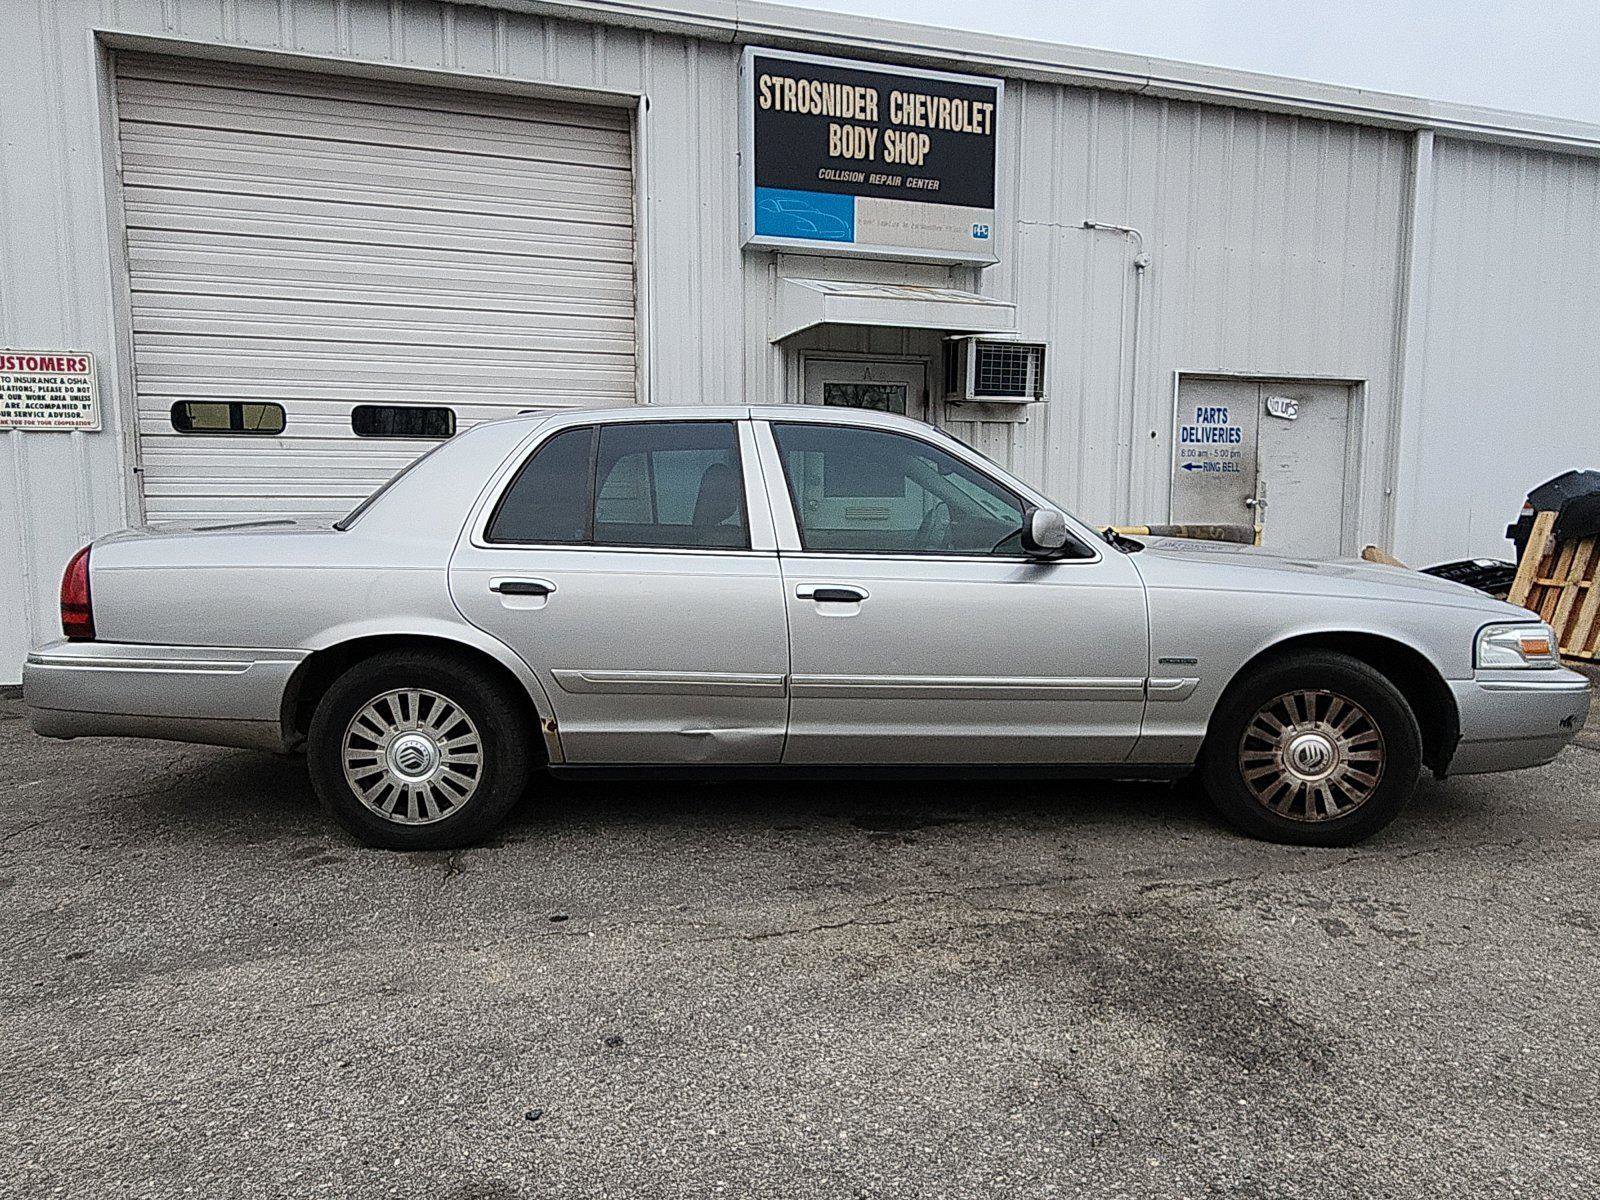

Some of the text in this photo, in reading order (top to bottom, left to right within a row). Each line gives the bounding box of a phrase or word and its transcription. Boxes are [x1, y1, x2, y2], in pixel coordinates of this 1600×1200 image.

[759, 74, 994, 135] STROSNIDER CHEVROLET
[829, 123, 930, 166] BODY SHOP
[818, 168, 940, 191] COLLISION REPAIR CENTER
[13, 376, 58, 385] INSURANCE
[67, 377, 88, 385] OSHA
[0, 385, 35, 393] LATIONS,
[77, 386, 90, 394] NOT
[25, 402, 78, 410] ACCOMPANIED
[48, 411, 84, 419] ADVISOR.
[1196, 407, 1228, 424] PARTS
[1181, 426, 1242, 443] DELIVERIES
[1198, 450, 1209, 458] am
[1230, 451, 1241, 459] pm
[1203, 461, 1240, 472] RING BELL
